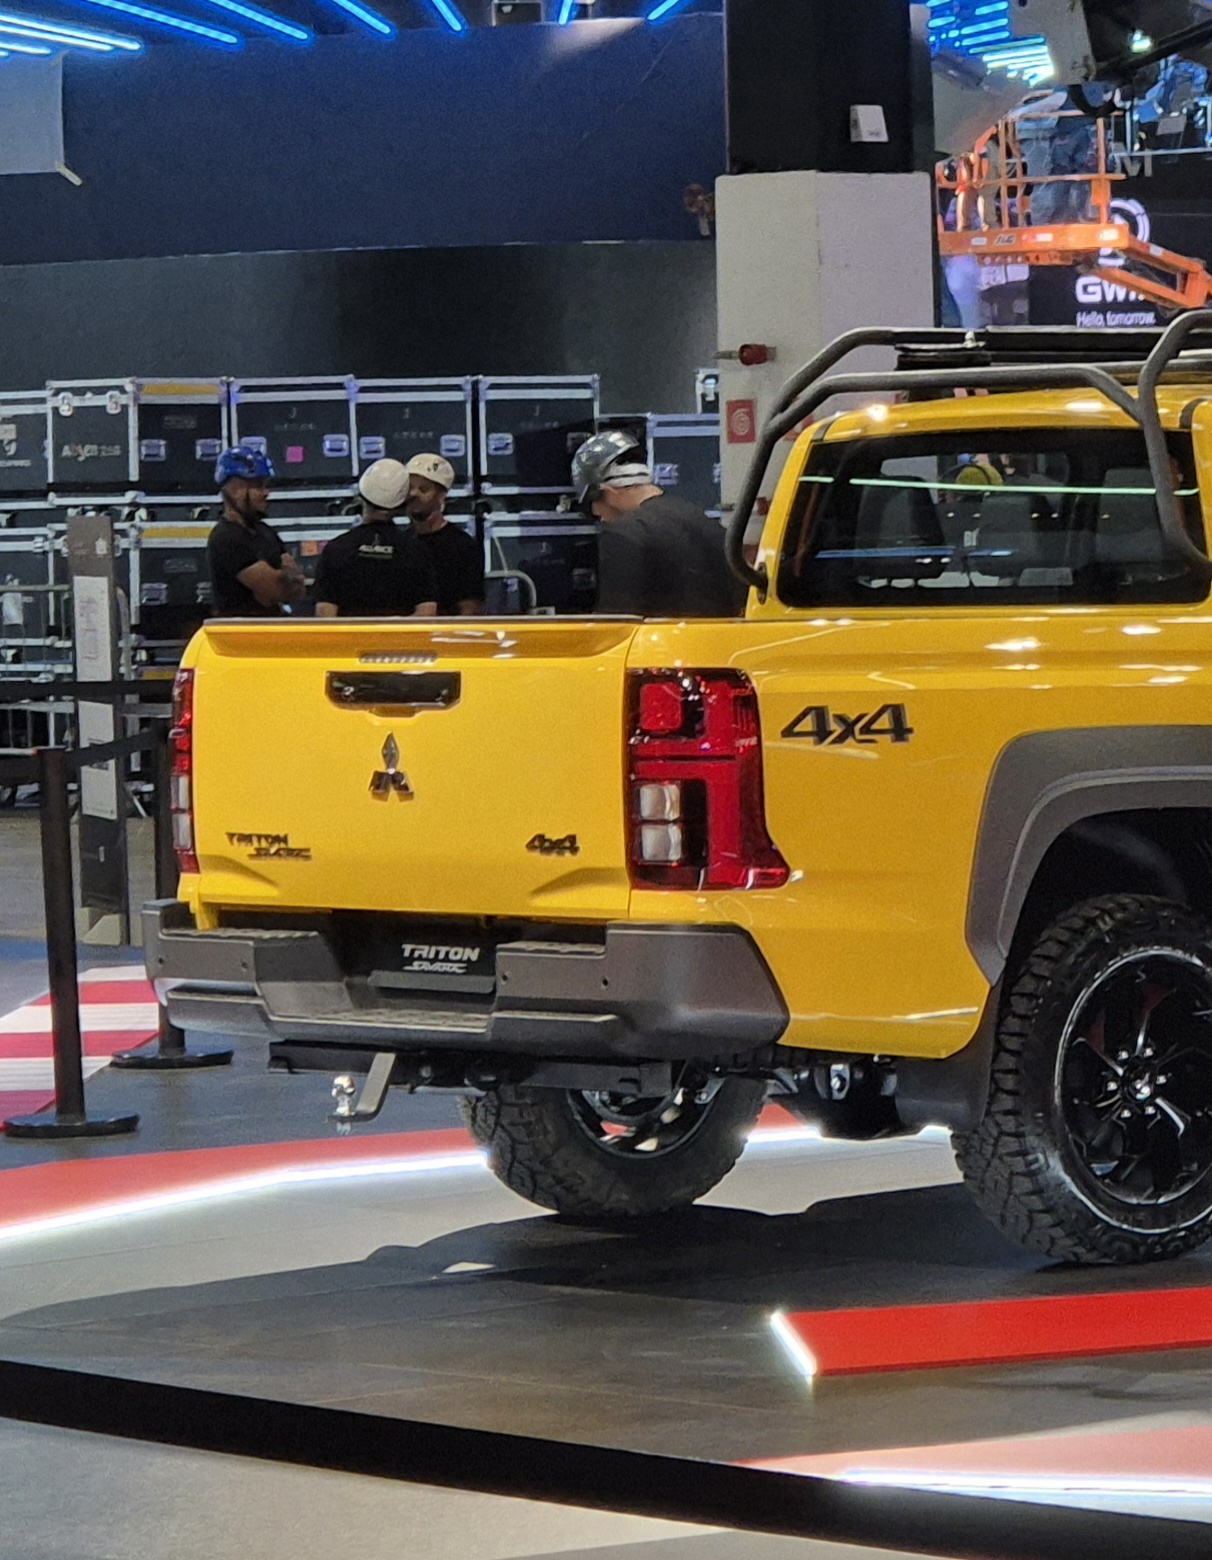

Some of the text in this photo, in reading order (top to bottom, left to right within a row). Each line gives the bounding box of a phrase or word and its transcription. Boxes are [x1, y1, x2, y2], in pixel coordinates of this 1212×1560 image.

[781, 703, 914, 744] 4x4
[525, 833, 580, 856] 4x4
[401, 944, 481, 961] TRITON
